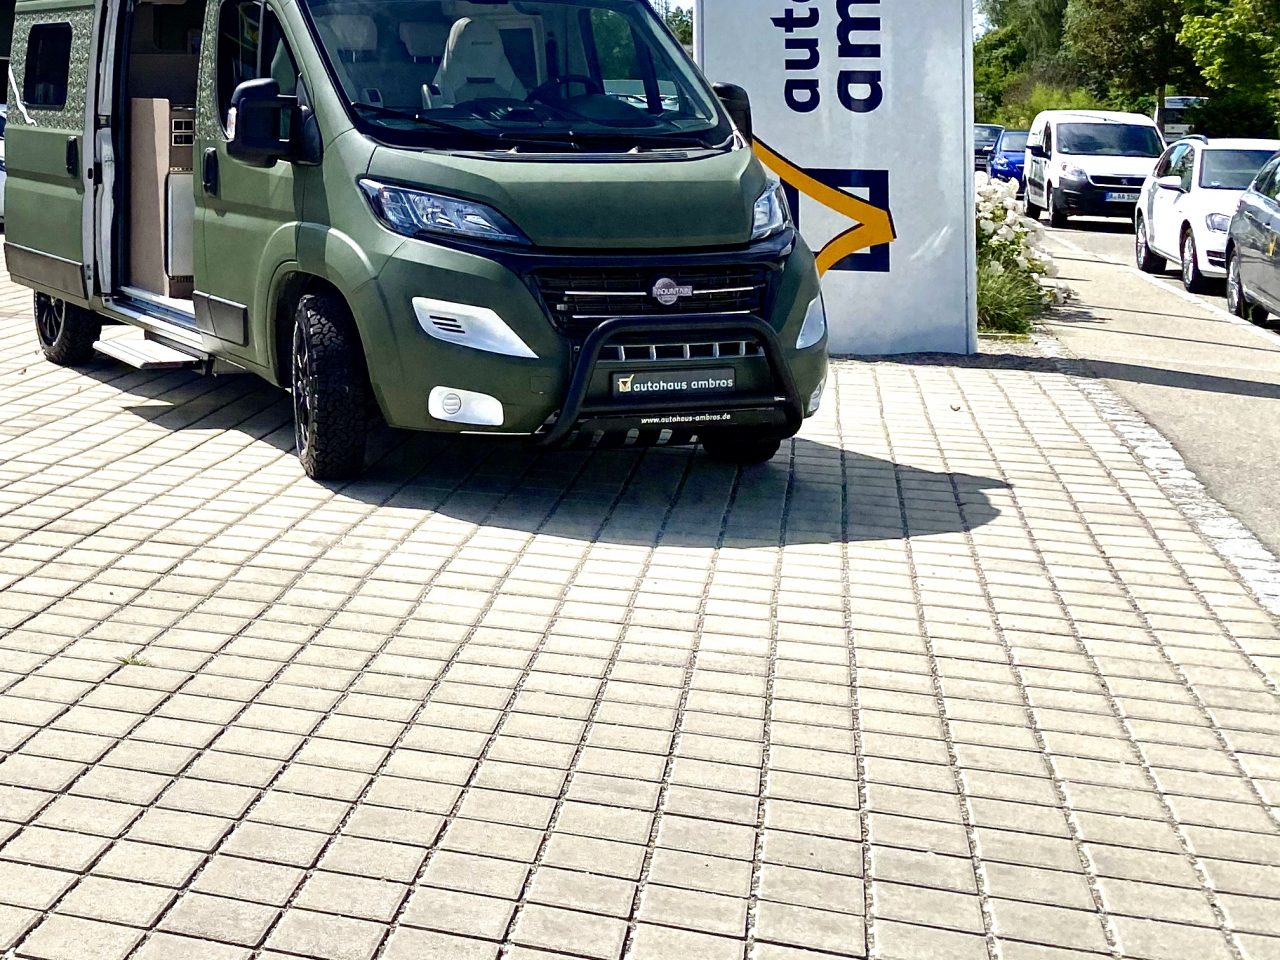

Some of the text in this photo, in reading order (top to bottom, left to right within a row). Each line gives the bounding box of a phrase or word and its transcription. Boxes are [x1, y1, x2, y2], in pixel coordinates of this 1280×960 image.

[633, 378, 734, 392] autohaus ambros
[641, 412, 731, 424] www.autohaus-ambros.de
